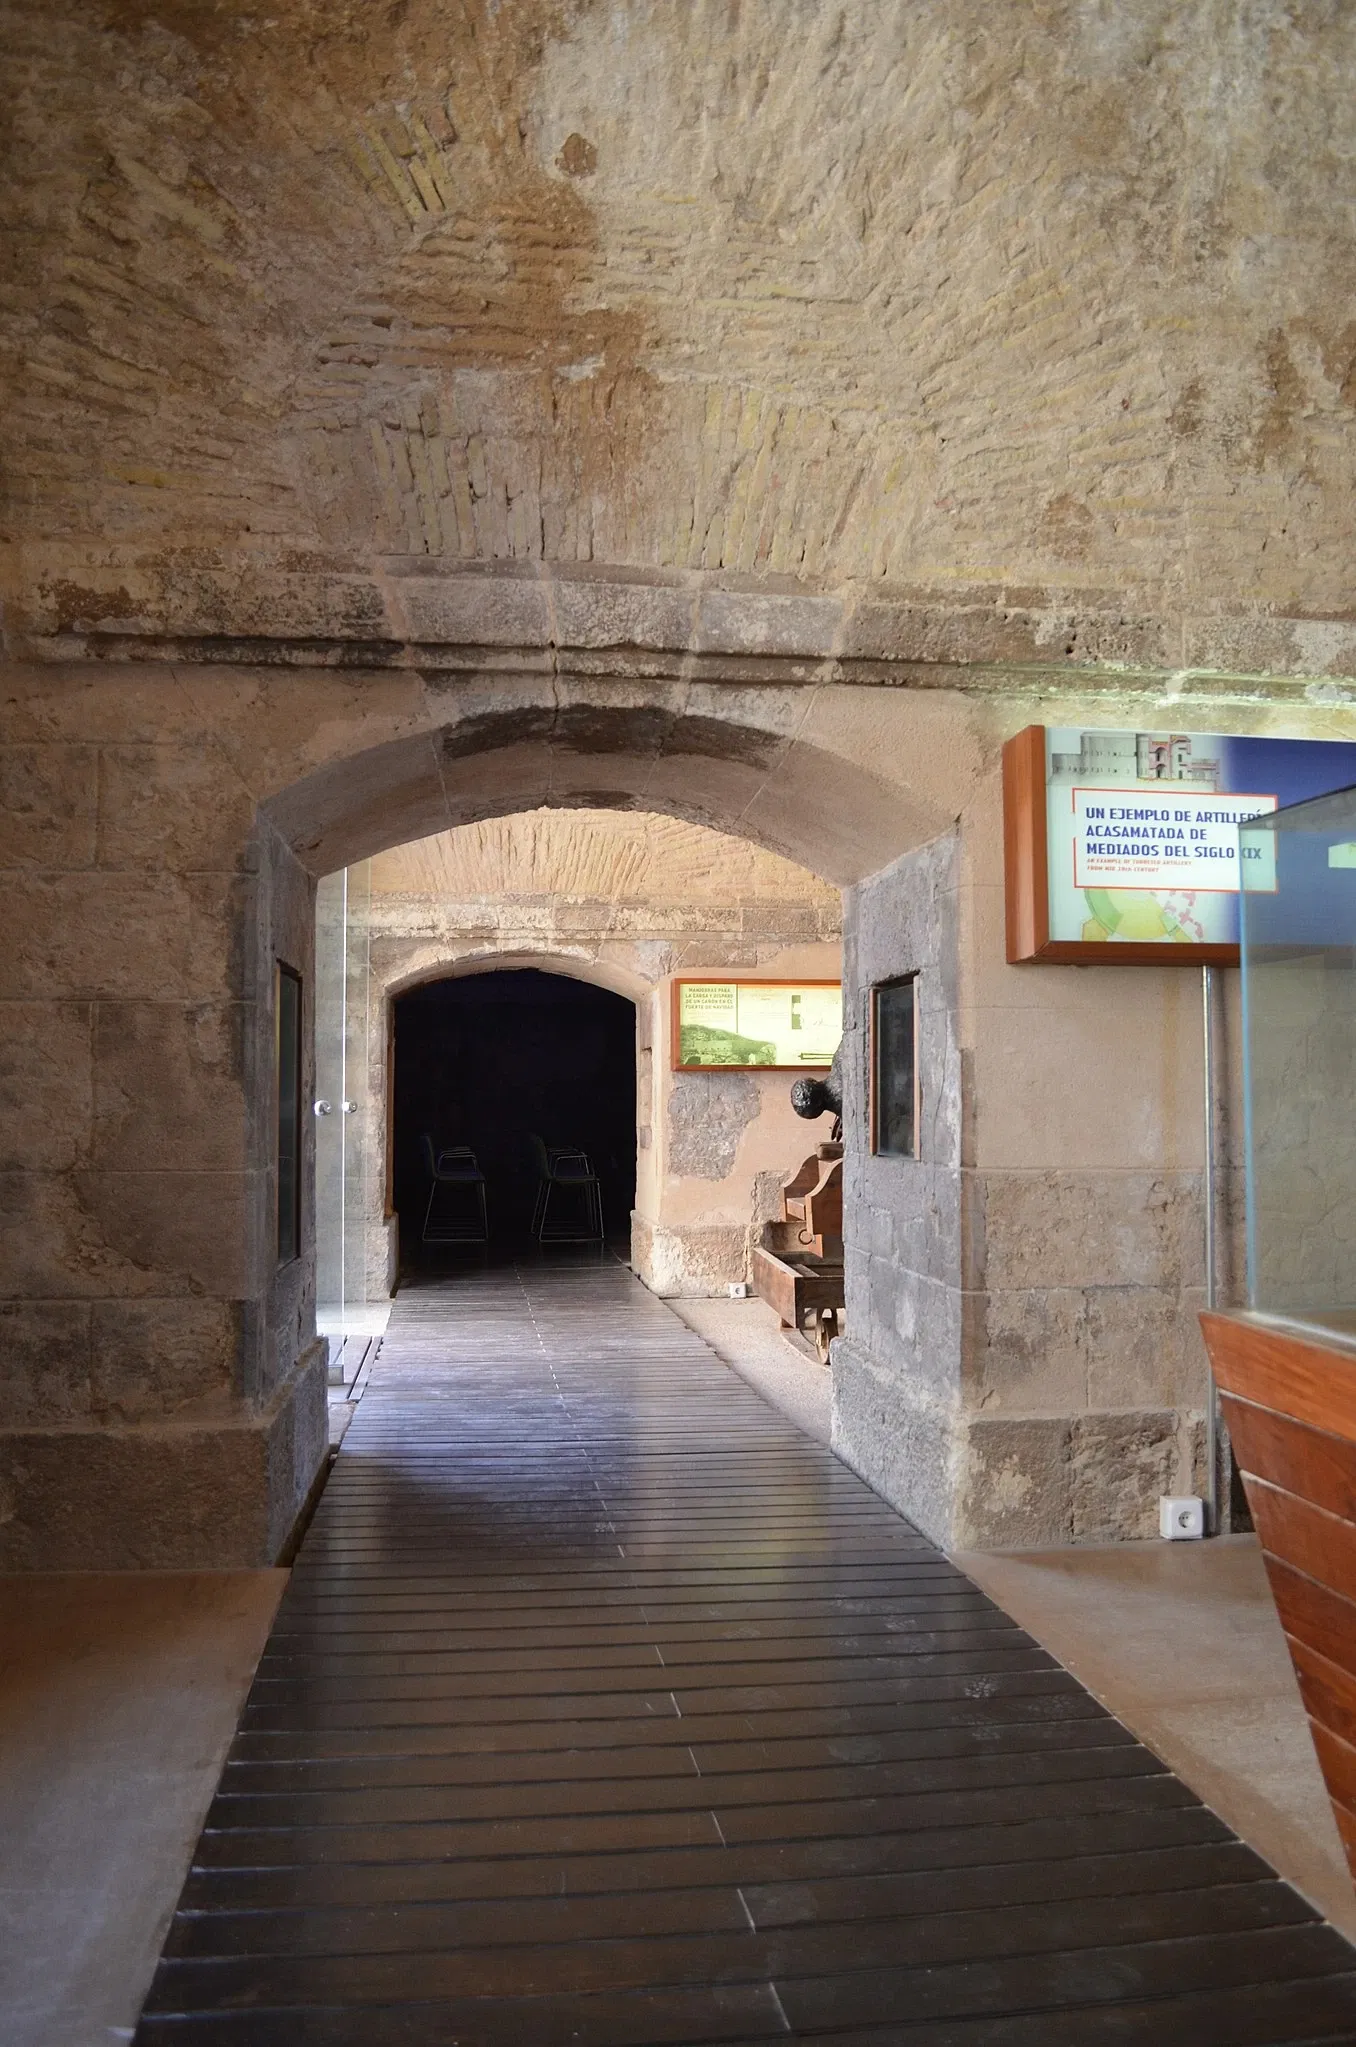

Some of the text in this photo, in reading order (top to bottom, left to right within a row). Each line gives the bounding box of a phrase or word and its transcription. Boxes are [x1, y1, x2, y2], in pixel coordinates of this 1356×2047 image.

[1086, 807, 1105, 819] UN
[1109, 808, 1170, 821] EJEMPLO
[1174, 810, 1191, 822] DE
[1086, 825, 1207, 840] ACASAMATADA DE
[1086, 842, 1159, 856] MEDIADOS
[1164, 845, 1190, 857] DEL
[1194, 846, 1235, 858] SIGLO
